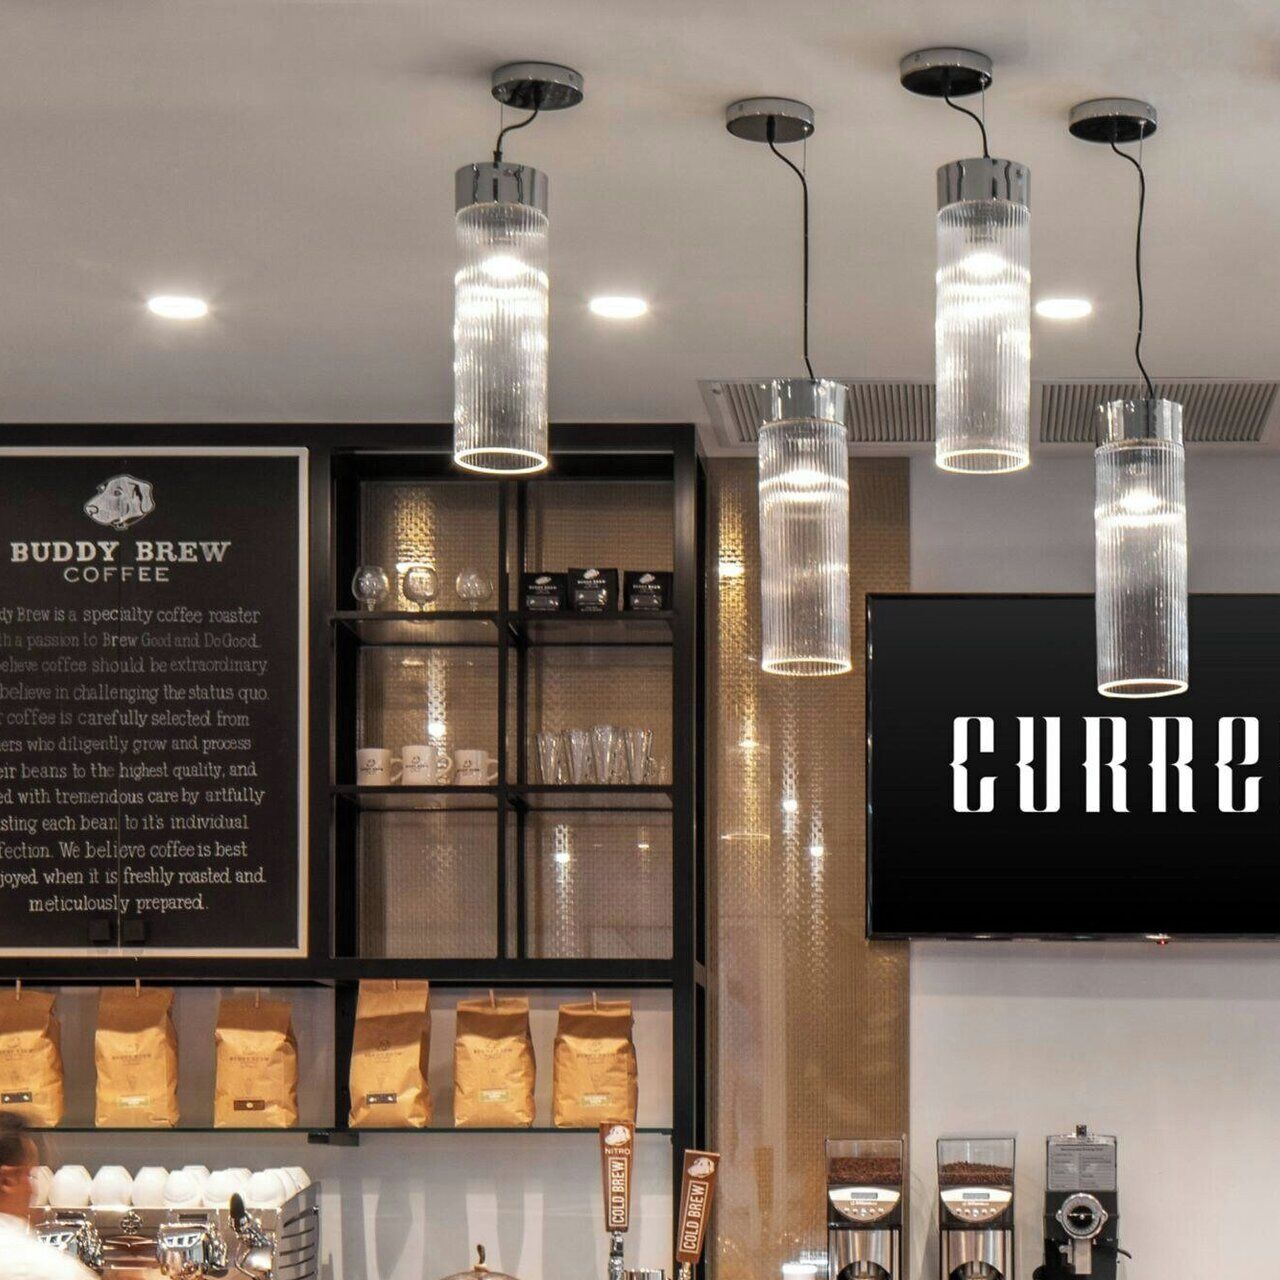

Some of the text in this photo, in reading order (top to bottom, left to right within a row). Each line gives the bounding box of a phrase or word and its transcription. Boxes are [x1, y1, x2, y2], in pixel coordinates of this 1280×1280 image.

[11, 542, 231, 562] BUDDY BREW
[64, 566, 170, 582] COFFEE
[17, 606, 50, 622] Brew
[54, 610, 65, 622] is
[83, 606, 153, 626] specialty
[157, 606, 203, 624] coffee
[209, 606, 261, 624] roaster
[26, 634, 79, 651] passion
[84, 632, 98, 648] to
[103, 632, 137, 648] Brew
[141, 632, 172, 648] Good
[174, 632, 199, 648] and
[41, 656, 87, 672] coffee
[92, 656, 145, 674] should
[150, 656, 167, 672] be
[0, 682, 51, 700] believe
[55, 684, 69, 700] in
[73, 684, 159, 704] challenging
[163, 684, 186, 700] the
[189, 684, 233, 700] status
[238, 688, 270, 704] quo.
[7, 708, 55, 726] coffee
[60, 710, 72, 726] is
[78, 708, 147, 728] carefully
[151, 708, 211, 726] selected
[217, 710, 250, 726] from
[26, 736, 55, 752] who
[58, 734, 128, 754] diligently
[133, 738, 166, 754] grow
[172, 734, 199, 750] and
[202, 738, 251, 754] process
[21, 762, 67, 780] beans
[72, 762, 85, 778] to
[90, 762, 115, 778] the
[120, 762, 169, 782] highest
[172, 762, 225, 780] quality,
[229, 760, 257, 776] and
[18, 788, 51, 804] with
[55, 788, 144, 804] tremendous
[148, 792, 178, 804] care
[182, 786, 199, 806] by
[205, 786, 265, 806] artfully
[42, 816, 76, 832] each
[80, 814, 118, 830] bean
[125, 814, 138, 830] to
[171, 814, 249, 830] individual
[59, 840, 81, 858] We
[85, 840, 145, 858] believe
[150, 840, 195, 858] coffee
[198, 844, 211, 858] is
[215, 840, 248, 858] best
[43, 868, 84, 884] when
[89, 868, 99, 884] it
[105, 870, 118, 884] is
[123, 866, 174, 886] freshly
[178, 866, 232, 884] roasted
[235, 866, 267, 884] and
[29, 892, 209, 914] meticulously prepared.
[604, 1148, 630, 1156] NITRO
[612, 1158, 625, 1224] COLD BREW
[684, 1184, 705, 1250] COLD BREW
